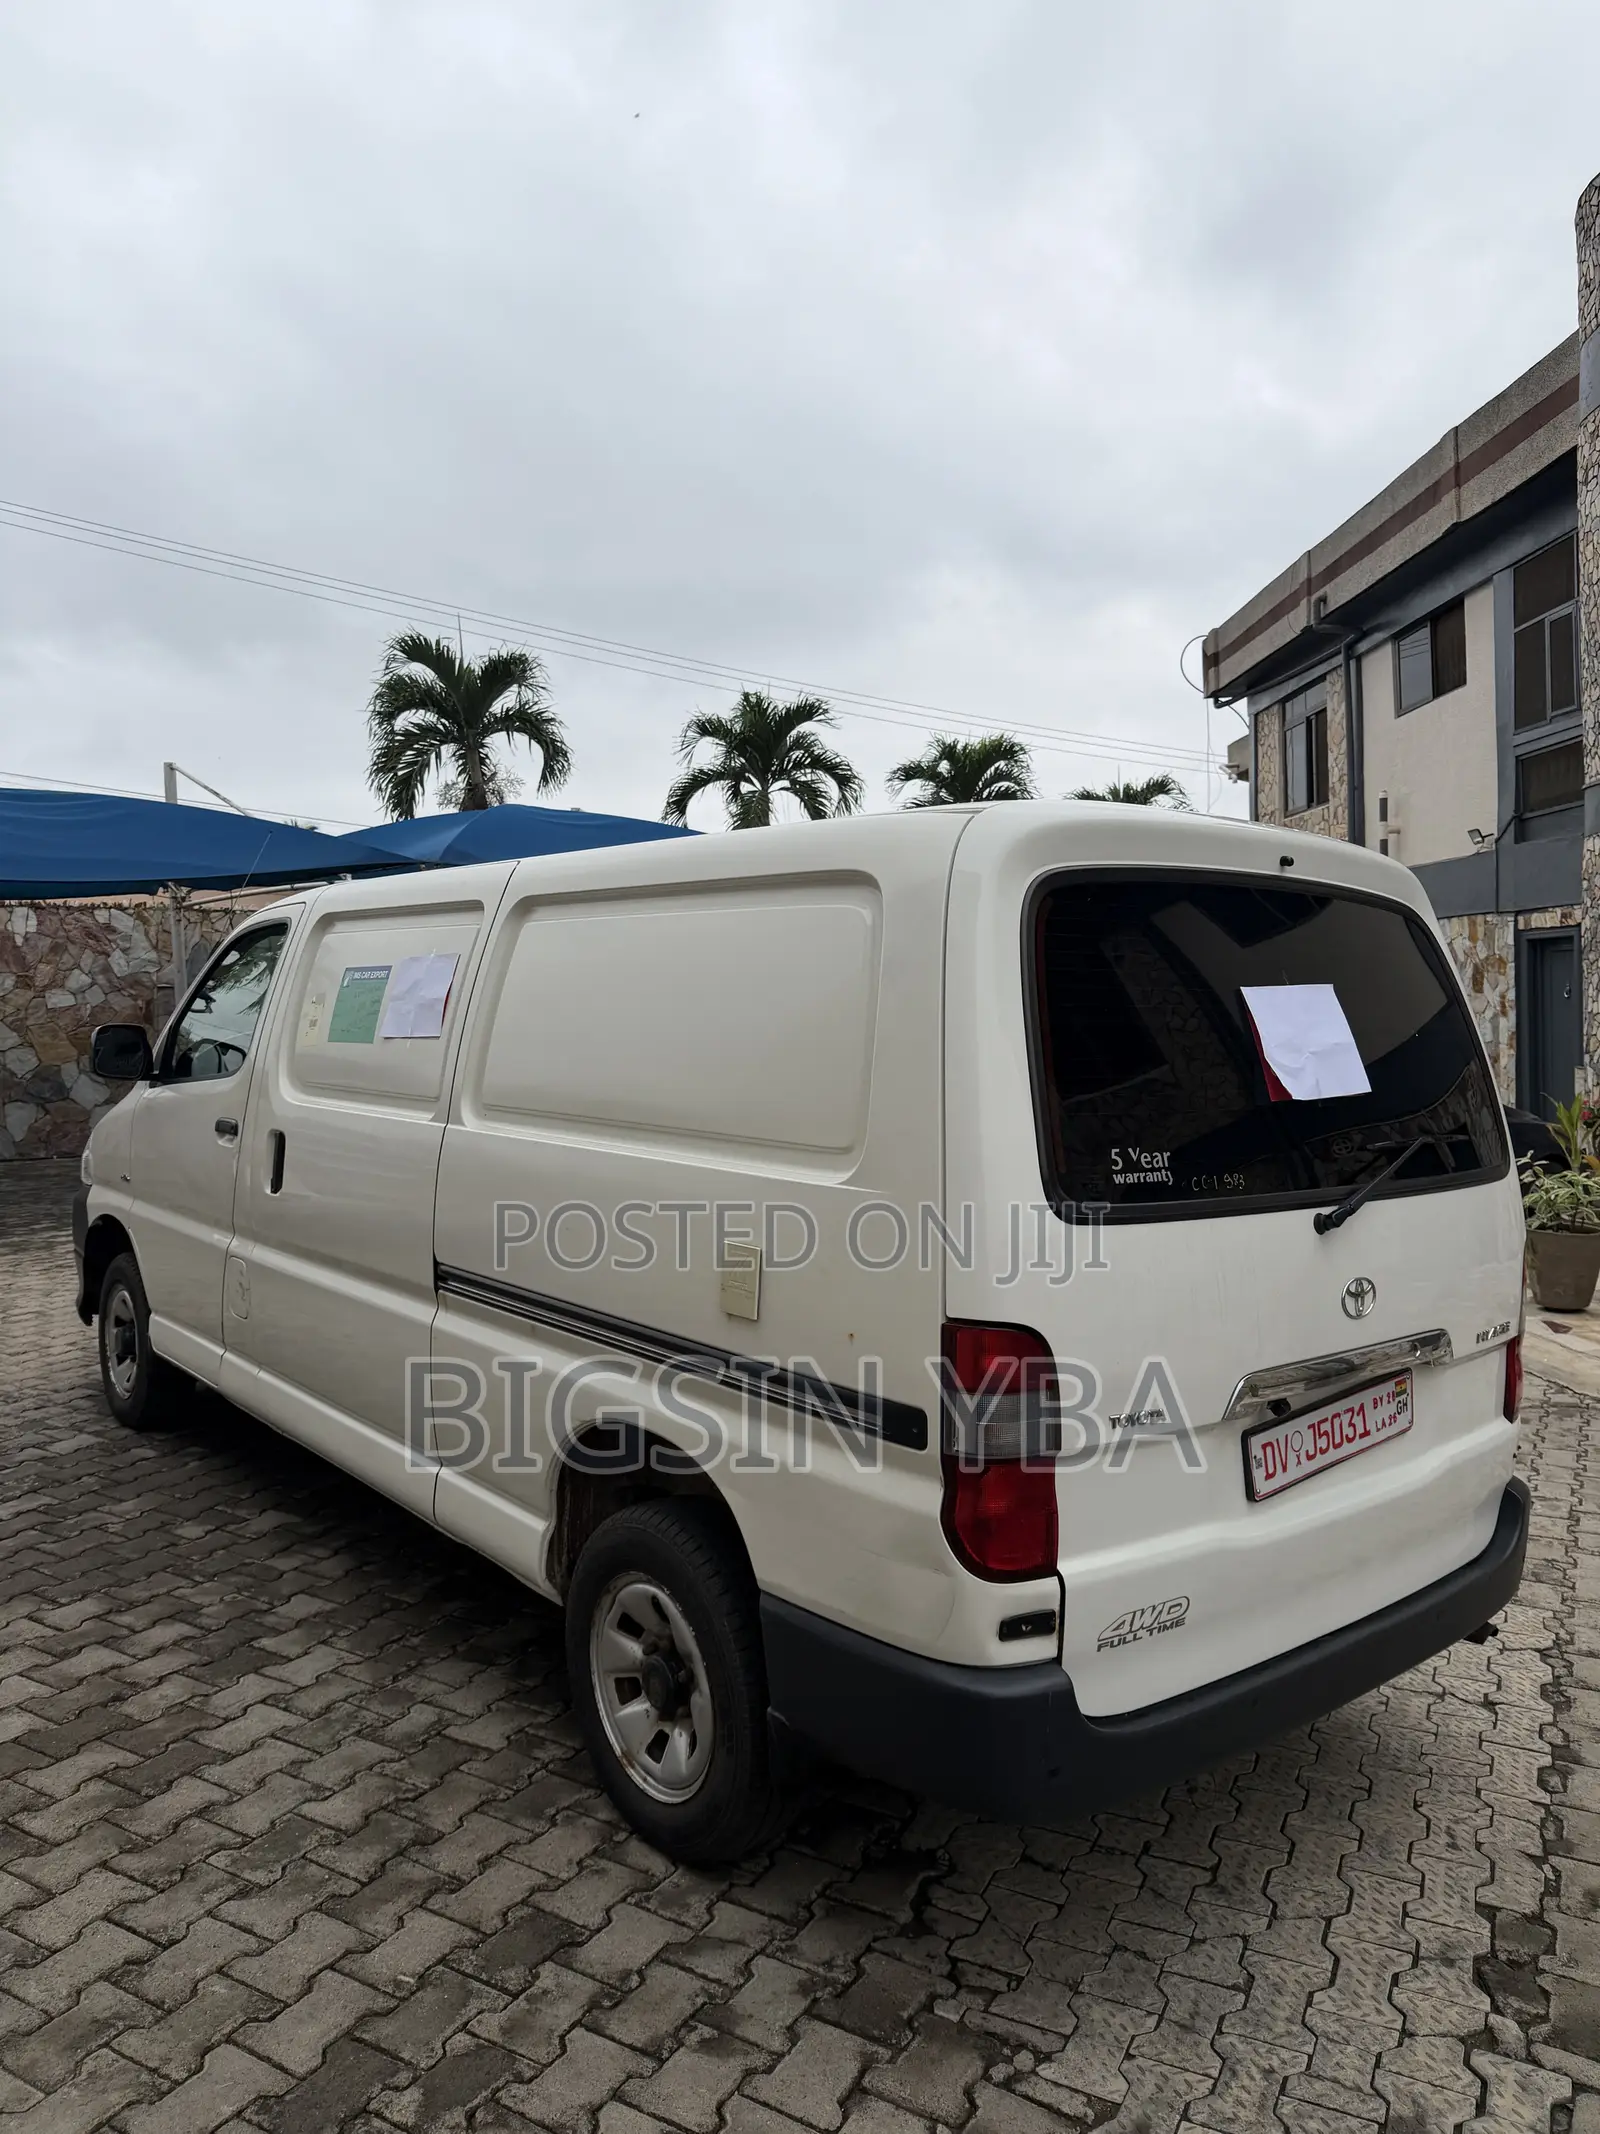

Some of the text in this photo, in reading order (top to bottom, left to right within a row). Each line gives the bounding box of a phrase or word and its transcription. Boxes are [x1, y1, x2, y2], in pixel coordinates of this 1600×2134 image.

[370, 970, 389, 978] EXPORT
[1111, 1148, 1123, 1170] 5
[1113, 1169, 1174, 1186] warranty
[1396, 1397, 1408, 1416] GH
[1109, 1408, 1167, 1429] TOYOTA
[1375, 1417, 1387, 1433] LA
[1261, 1402, 1371, 1481] DV J5031
[1097, 1595, 1190, 1642] 4WD
[1096, 1617, 1187, 1653] FULL TIME
